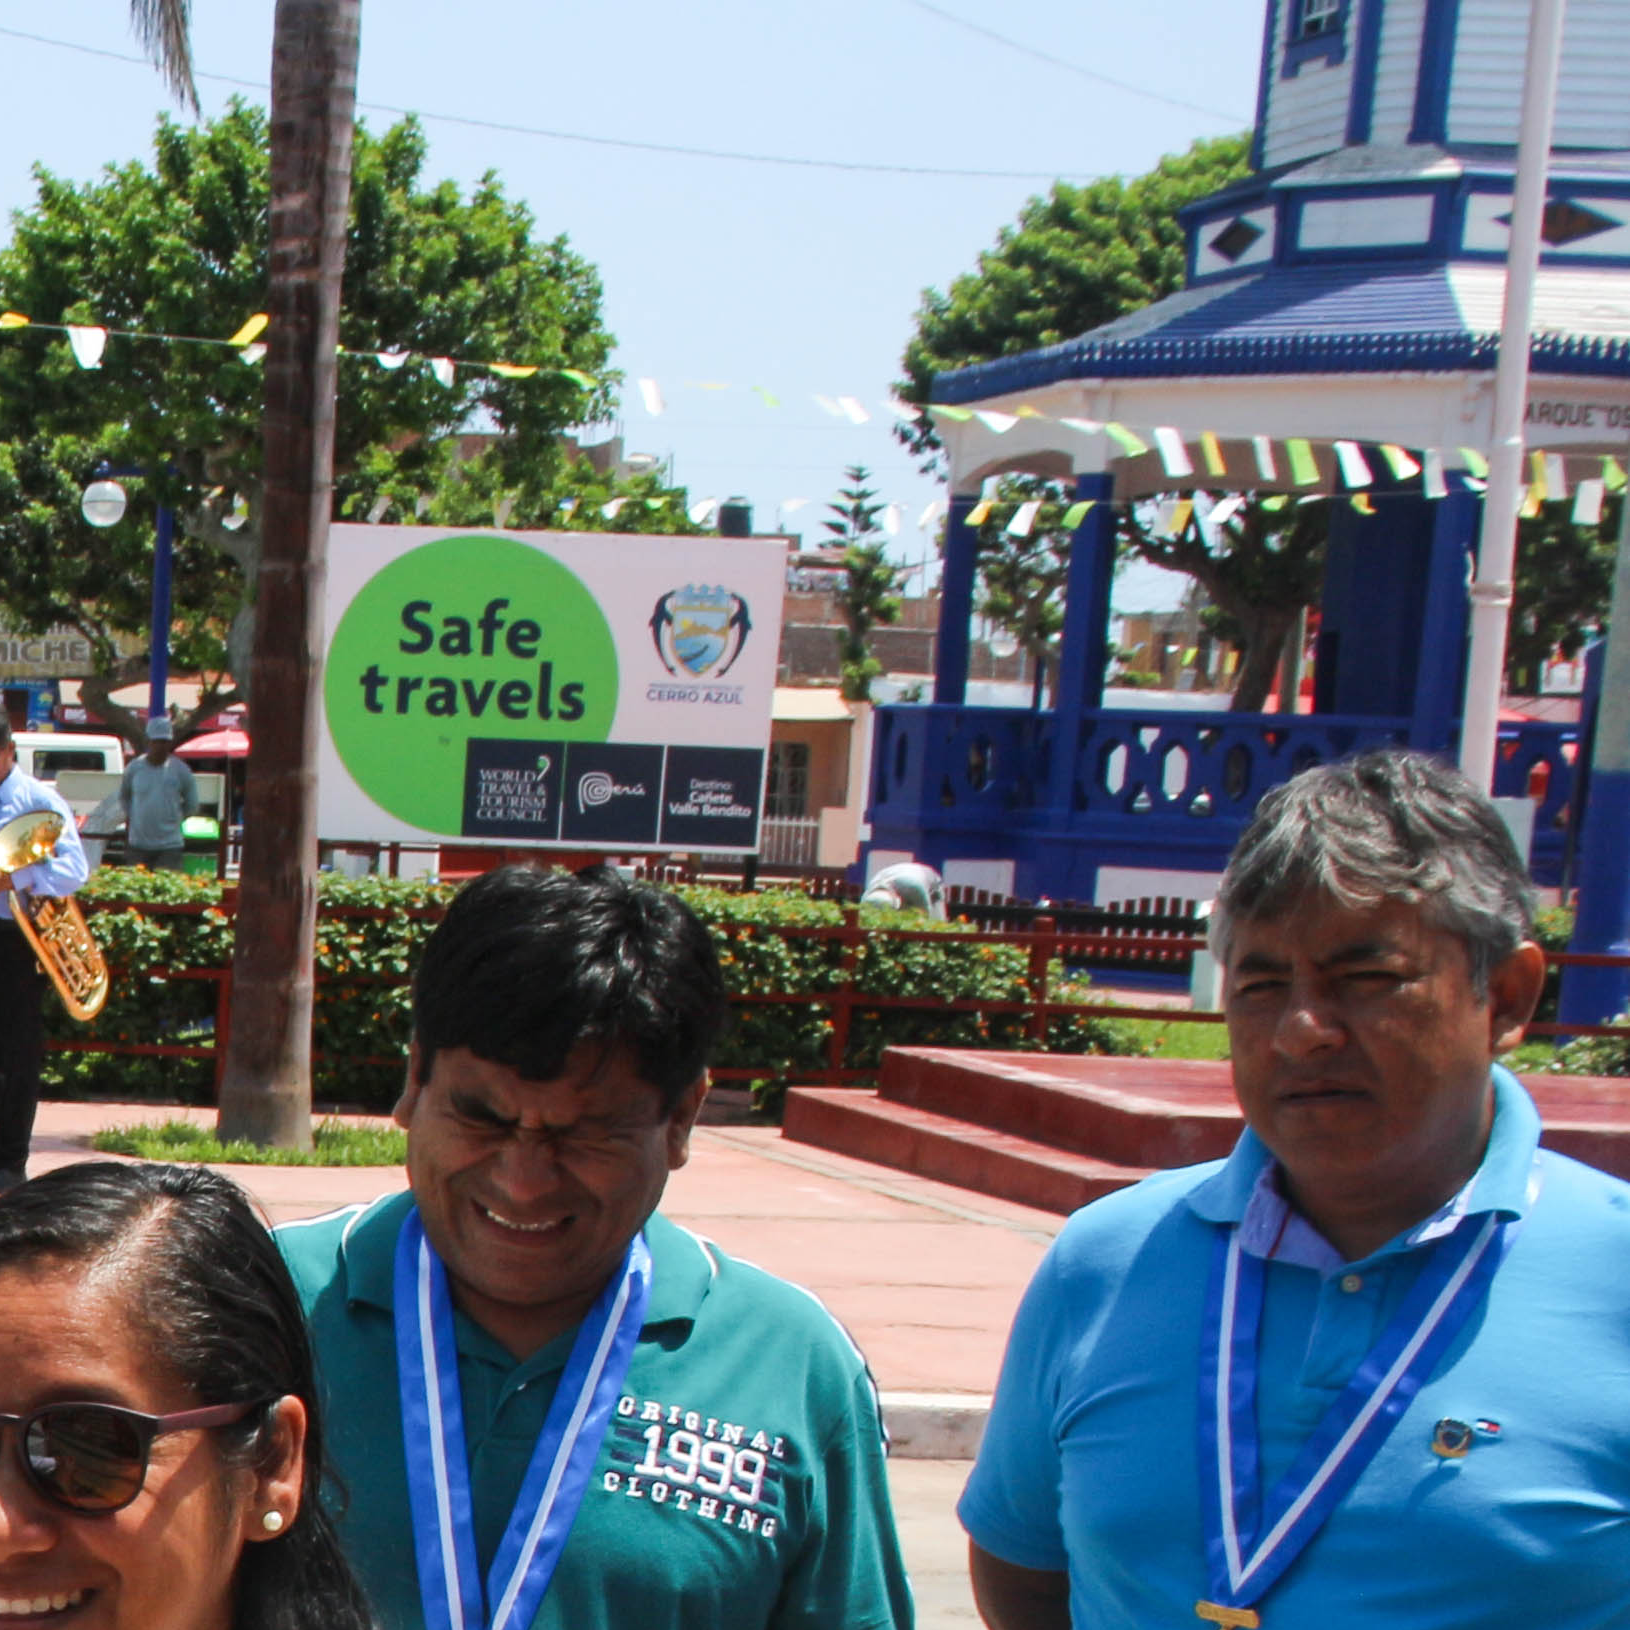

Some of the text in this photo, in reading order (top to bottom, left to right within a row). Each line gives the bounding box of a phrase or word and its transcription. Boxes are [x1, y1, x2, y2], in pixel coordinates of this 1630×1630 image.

[1522, 401, 1596, 428] ARQUE
[399, 597, 543, 659] Safe
[359, 660, 586, 722] travels
[645, 688, 742, 705] CERRO AZUL
[480, 768, 538, 782] WORLD
[478, 781, 533, 797] TRAVEL
[689, 790, 734, 805] Cañete
[478, 795, 547, 809] TOURISM
[668, 801, 753, 818] Valle Bendito
[476, 808, 547, 822] COUNCIL
[617, 1395, 786, 1459] ORIGINAL
[634, 1423, 767, 1506] 1999
[603, 1471, 778, 1538] CLOTHING
